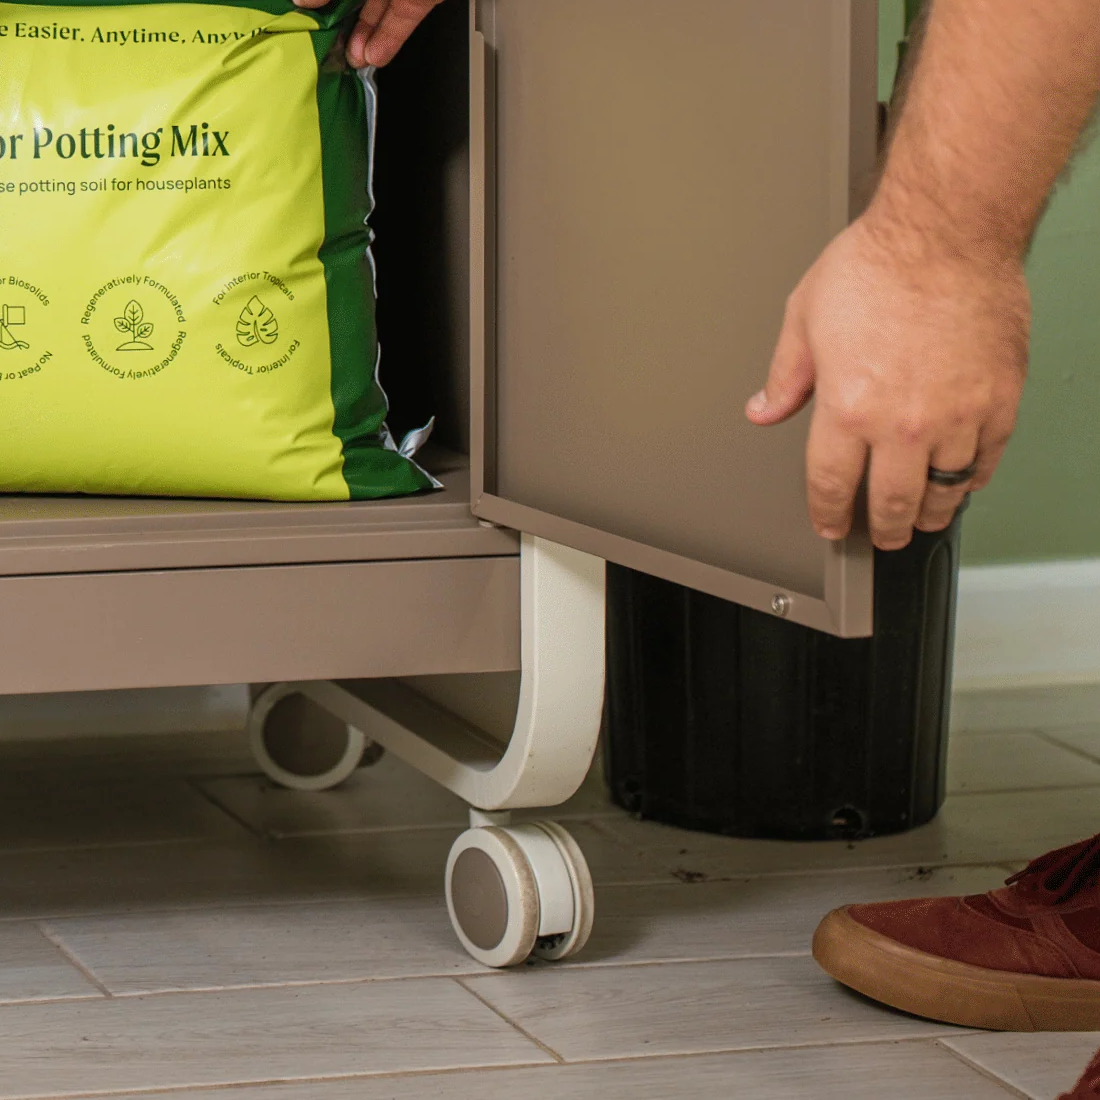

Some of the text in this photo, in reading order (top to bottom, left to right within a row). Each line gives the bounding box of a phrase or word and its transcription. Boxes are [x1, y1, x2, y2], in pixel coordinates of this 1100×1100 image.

[14, 22, 86, 42] Easier.
[90, 27, 186, 46] Anytime,
[32, 124, 163, 167] Potting
[170, 123, 230, 158] Mix
[18, 180, 76, 196] potting
[80, 178, 108, 192] soil
[111, 177, 132, 191] for
[136, 176, 231, 193] houseplants
[8, 276, 50, 307] Biosolids
[80, 274, 186, 325] Regeneratively Formulated
[212, 270, 295, 305] For Interior Tropicals
[39, 350, 53, 364] No
[82, 330, 186, 380] Regeneratively Formulated
[215, 339, 300, 375] For Interior Tropicals
[5, 372, 16, 380] or
[18, 364, 42, 379] Peat
